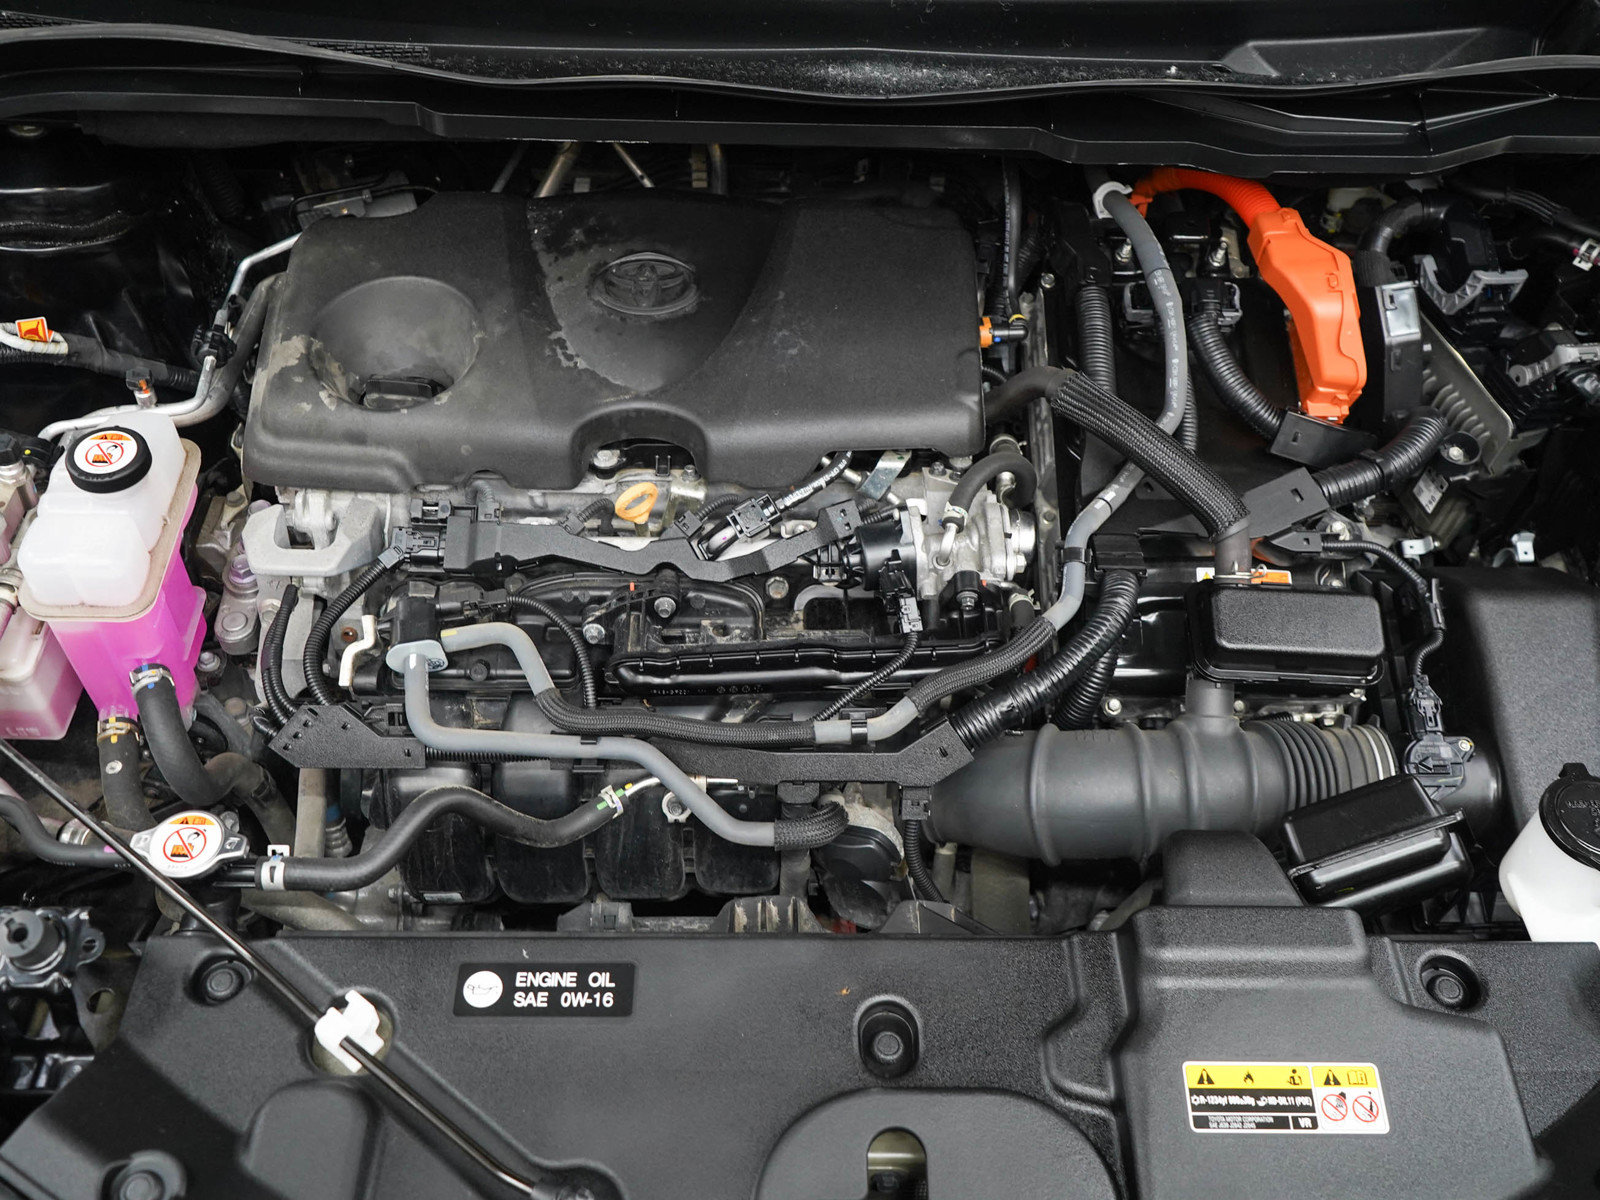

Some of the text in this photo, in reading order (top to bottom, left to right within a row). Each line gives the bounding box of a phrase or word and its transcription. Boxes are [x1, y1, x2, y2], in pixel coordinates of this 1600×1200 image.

[515, 972, 616, 988] ENGINE OIL
[513, 992, 614, 1008] SAE 0W-16
[1298, 1117, 1312, 1128] VR
